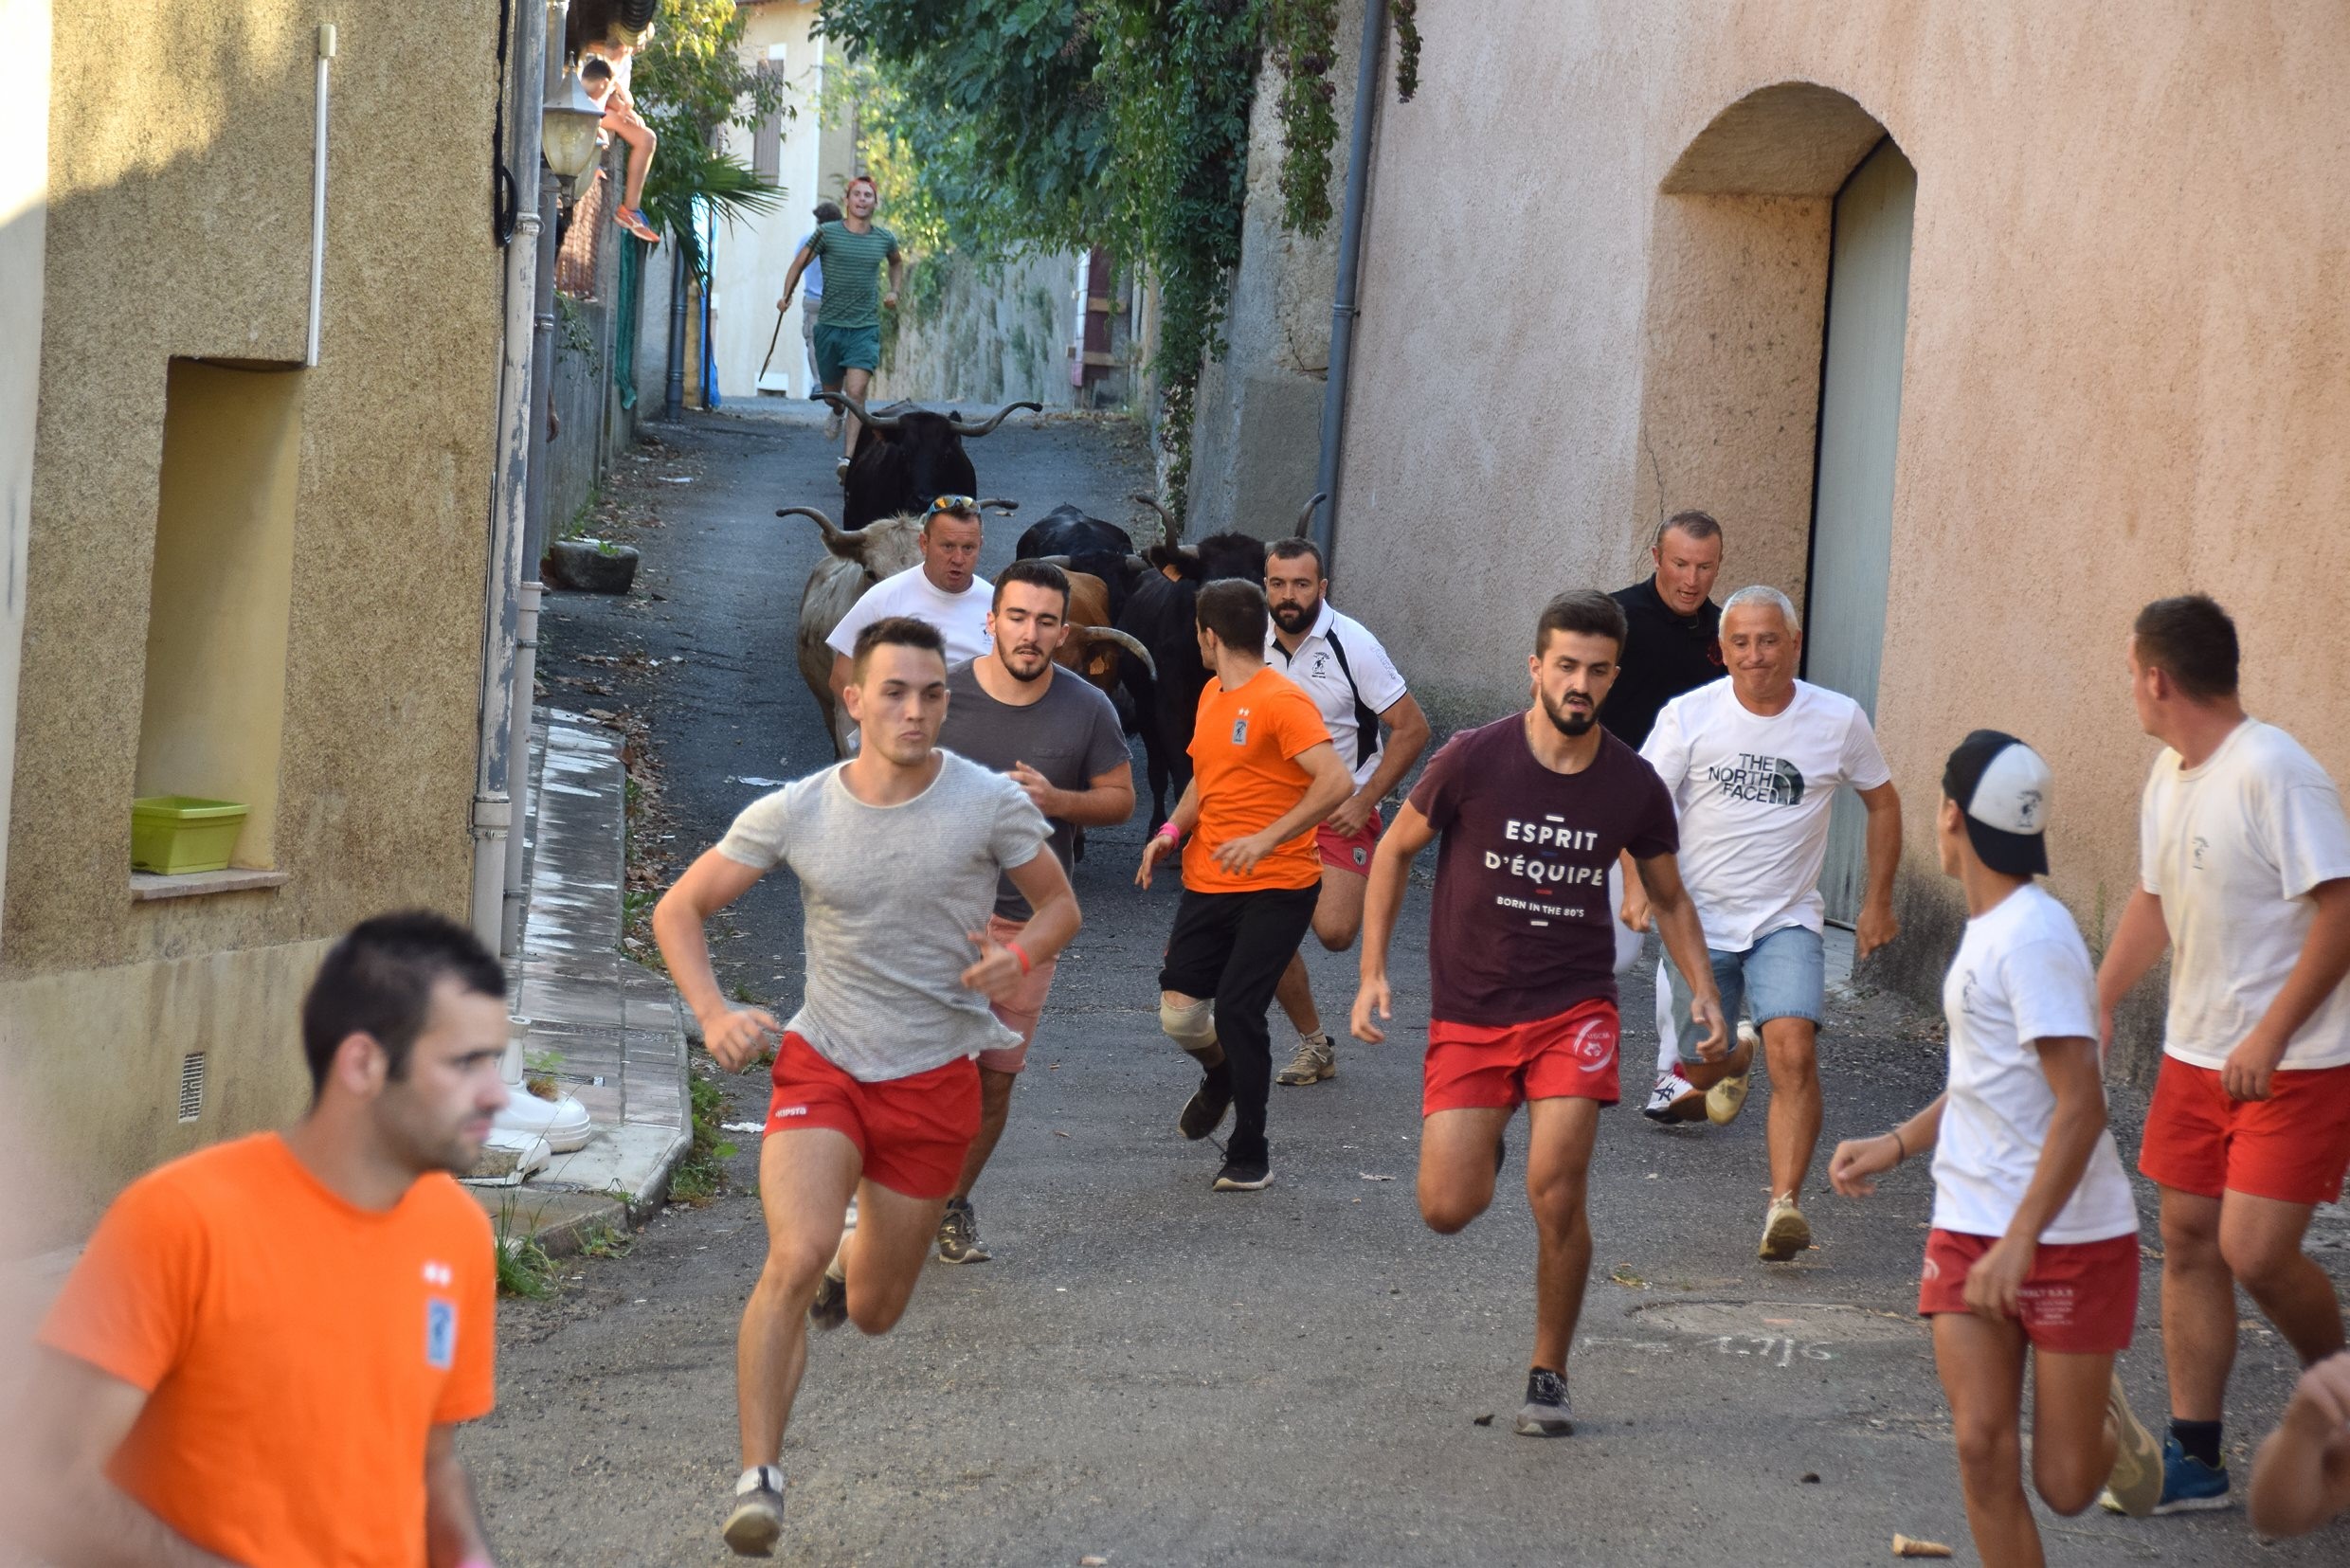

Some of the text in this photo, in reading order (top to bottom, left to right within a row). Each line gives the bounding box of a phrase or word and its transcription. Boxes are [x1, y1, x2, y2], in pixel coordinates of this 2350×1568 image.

[1739, 753, 1775, 771] THE
[1708, 766, 1773, 787] NORTH
[1723, 783, 1768, 802] FACE
[1506, 820, 1598, 851] ESPRIT
[1497, 896, 1527, 910] BORN
[1528, 902, 1541, 912] IN
[1544, 906, 1562, 915] THE
